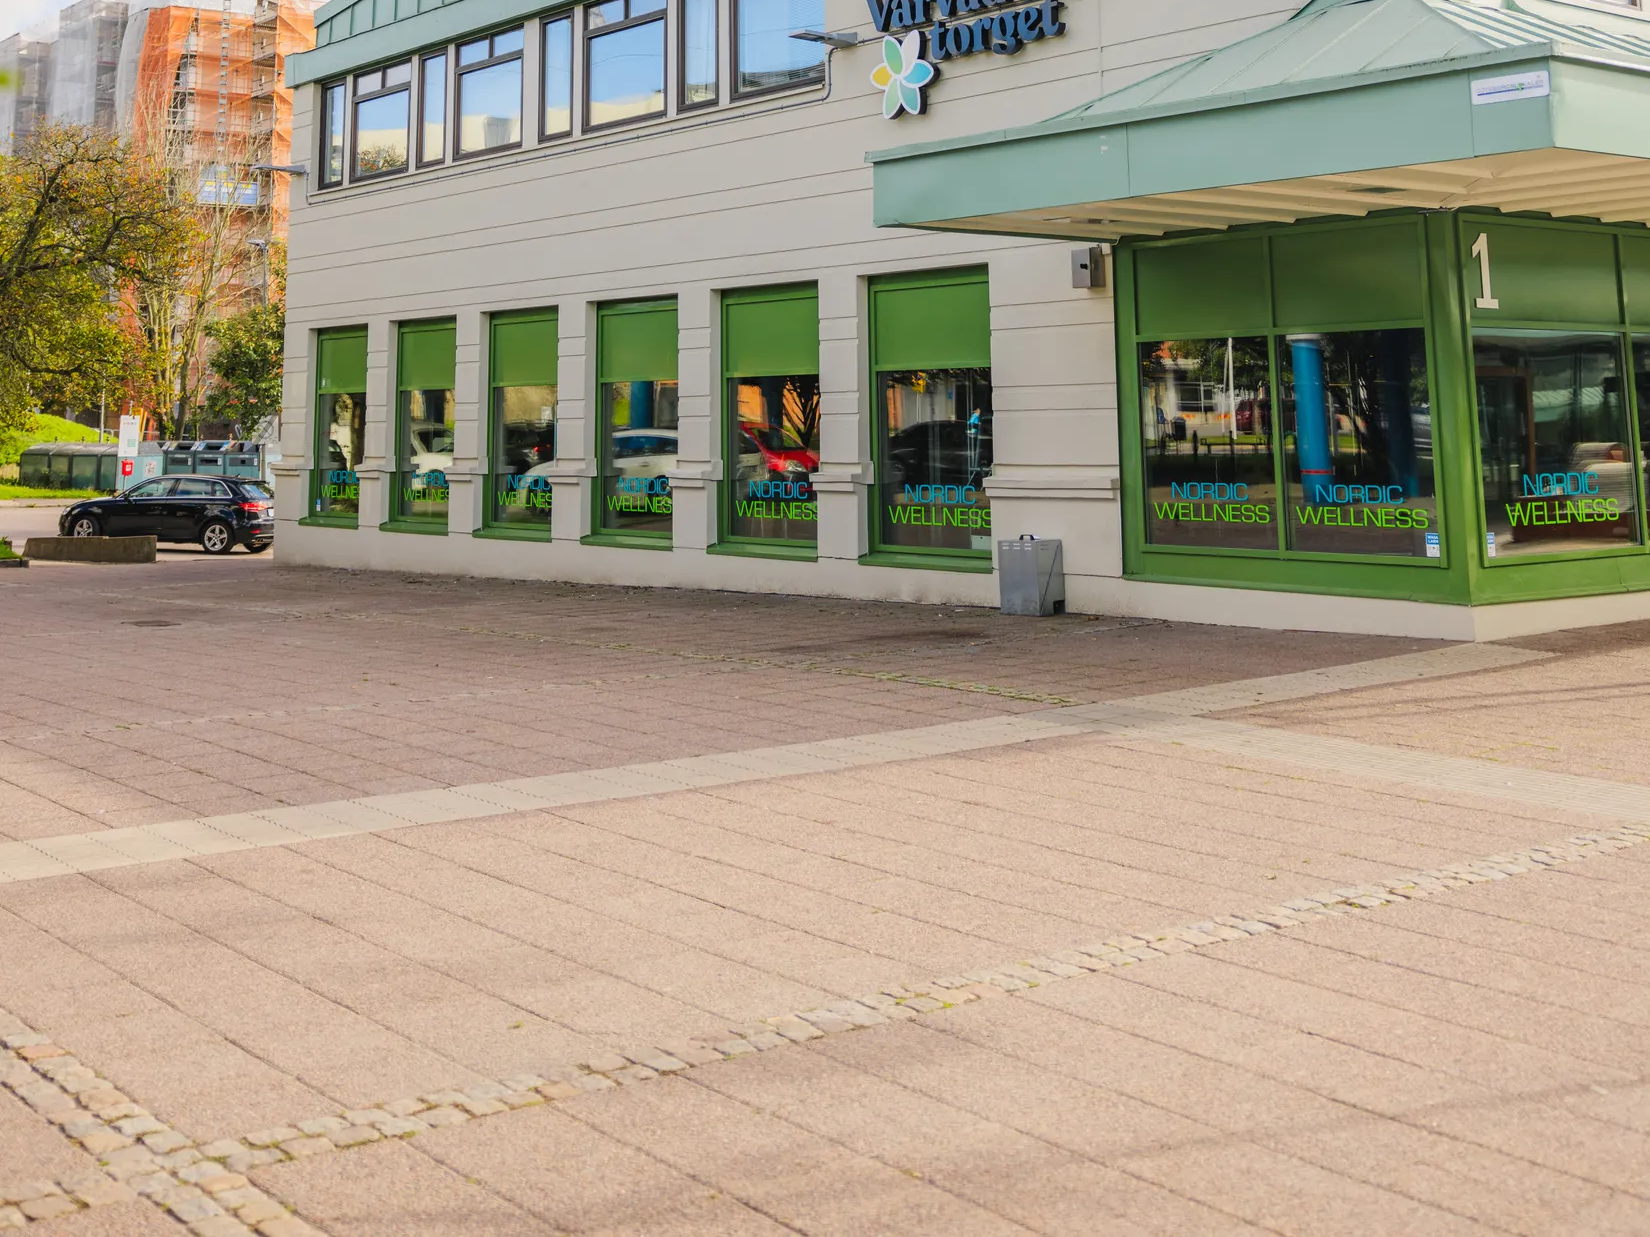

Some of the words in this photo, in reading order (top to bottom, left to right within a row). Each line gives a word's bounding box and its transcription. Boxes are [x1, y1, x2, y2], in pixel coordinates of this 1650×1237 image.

[1471, 232, 1499, 309] 1
[617, 476, 669, 494] NORDIC
[749, 480, 808, 499] NORDIC
[904, 484, 977, 505] NORDIC
[1171, 481, 1248, 501] NORDIC
[1315, 484, 1404, 505] NORDIC
[1522, 471, 1599, 497] NORDIC
[888, 505, 991, 528] WELLNESS
[1154, 502, 1270, 524] WELLNESS
[1296, 506, 1429, 530] WELLNESS
[1505, 498, 1619, 527] WELLNESS
